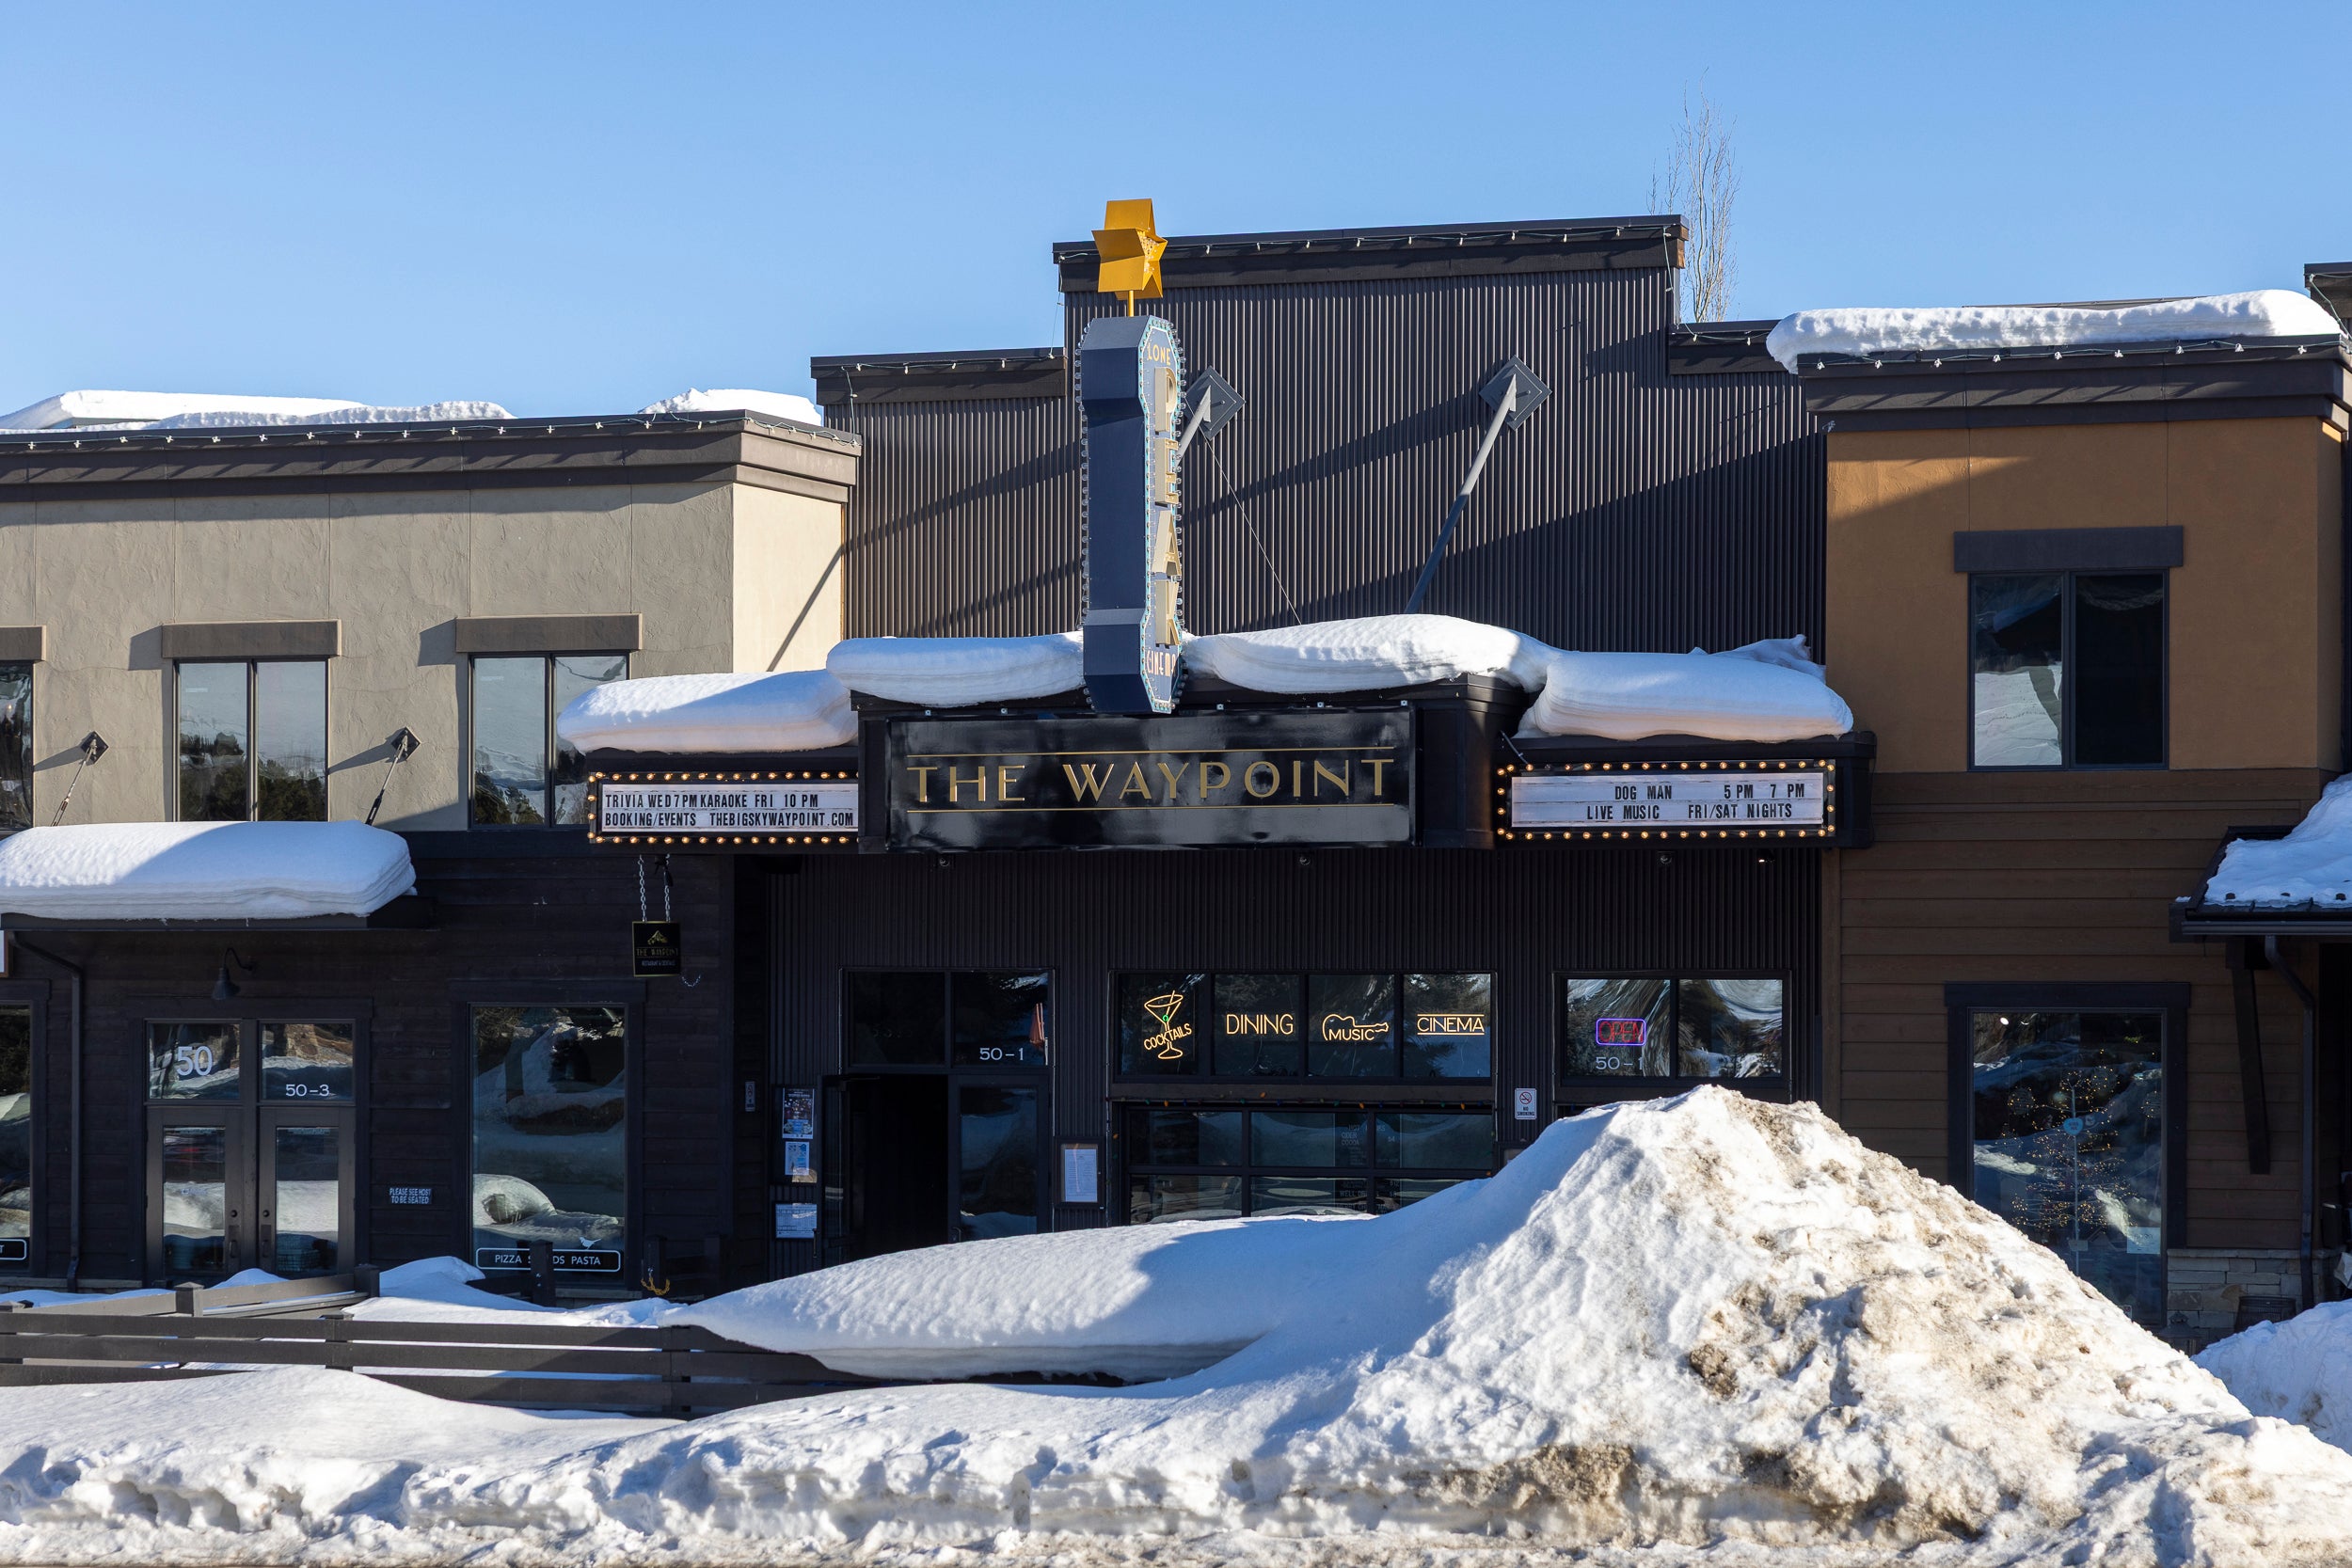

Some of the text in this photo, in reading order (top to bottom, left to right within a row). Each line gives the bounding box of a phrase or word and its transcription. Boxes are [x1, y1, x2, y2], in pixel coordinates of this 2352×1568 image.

[1148, 342, 1170, 366] LONE
[1152, 366, 1182, 646] PEAK
[907, 759, 1394, 802] THE WAYPOINT
[1614, 785, 1637, 800] DOG
[1647, 785, 1672, 800] MAN
[1770, 784, 1776, 798] 7
[1788, 784, 1804, 798] PM
[606, 794, 644, 807] TRIVIA
[648, 794, 672, 807] WED
[701, 794, 748, 807] KARAOKE
[755, 794, 773, 807] FRI
[785, 794, 796, 807] 10
[802, 794, 818, 807] PM
[605, 812, 697, 826] BOOKING/EVENTS
[1587, 803, 1792, 819] LIVE MUSIC FRI/SAT NIGHTS
[1226, 1014, 1294, 1035] DINING
[1417, 1017, 1485, 1033] CINEMA
[1598, 1022, 1645, 1043] OPEN
[1143, 1022, 1192, 1051] COCKTAILS
[1328, 1028, 1375, 1041] MUSIC
[176, 1046, 214, 1076] 50
[389, 1187, 432, 1196] PLEASE SEE HOST
[399, 1196, 407, 1204] BE
[407, 1196, 430, 1204] SEATED
[495, 1254, 522, 1264] PIZZA
[571, 1256, 601, 1265] PASTA
